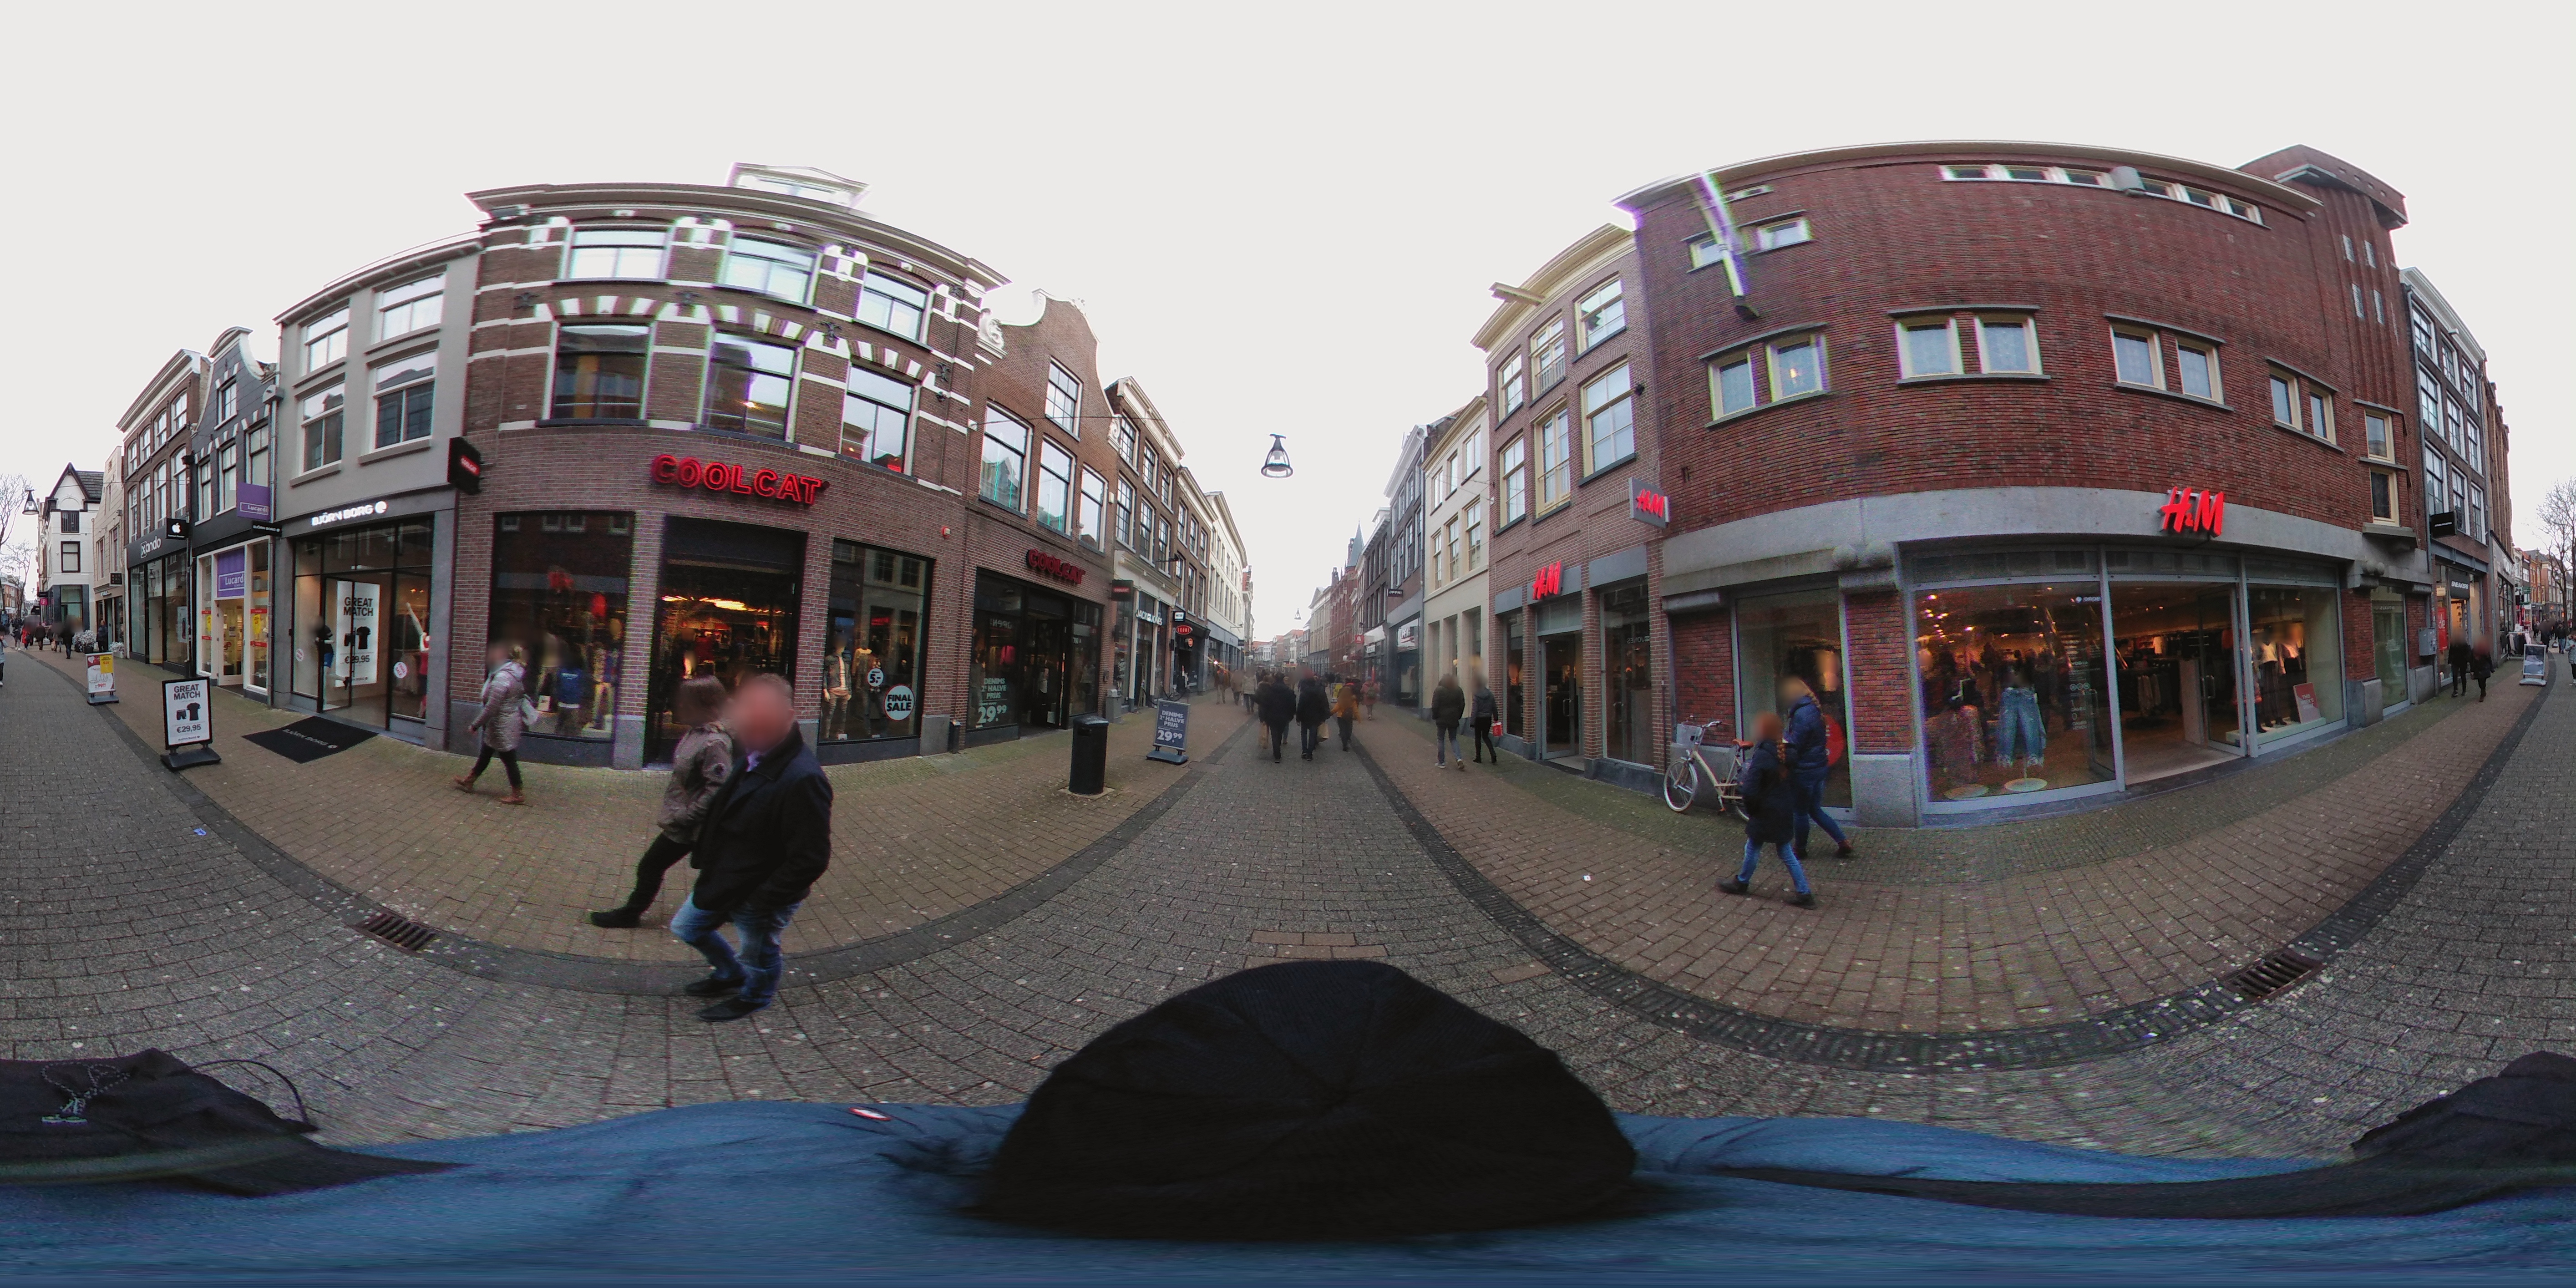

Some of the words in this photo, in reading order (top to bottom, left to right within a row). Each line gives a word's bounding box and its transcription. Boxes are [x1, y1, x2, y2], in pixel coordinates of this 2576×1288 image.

[651, 454, 821, 505] COOLCAT
[1636, 488, 1664, 517] H&M
[248, 504, 267, 512] Lucardi
[2160, 486, 2224, 536] H&M
[312, 511, 342, 526] BJÖRN
[343, 504, 374, 519] BORG
[1028, 548, 1085, 584] COOLCAT
[1531, 560, 1561, 600] H&M
[2451, 581, 2469, 589] SNEAKERS
[344, 597, 373, 607] GREAT
[343, 606, 374, 617] MATCH
[1136, 609, 1148, 621] JACK
[1151, 615, 1162, 626] JONES
[174, 684, 199, 693] GREAT
[174, 690, 201, 700] MATCH
[887, 702, 912, 711] SALE
[1161, 710, 1183, 719] DENIMS
[1165, 716, 1185, 724] HALVE
[177, 724, 201, 733] €29,95
